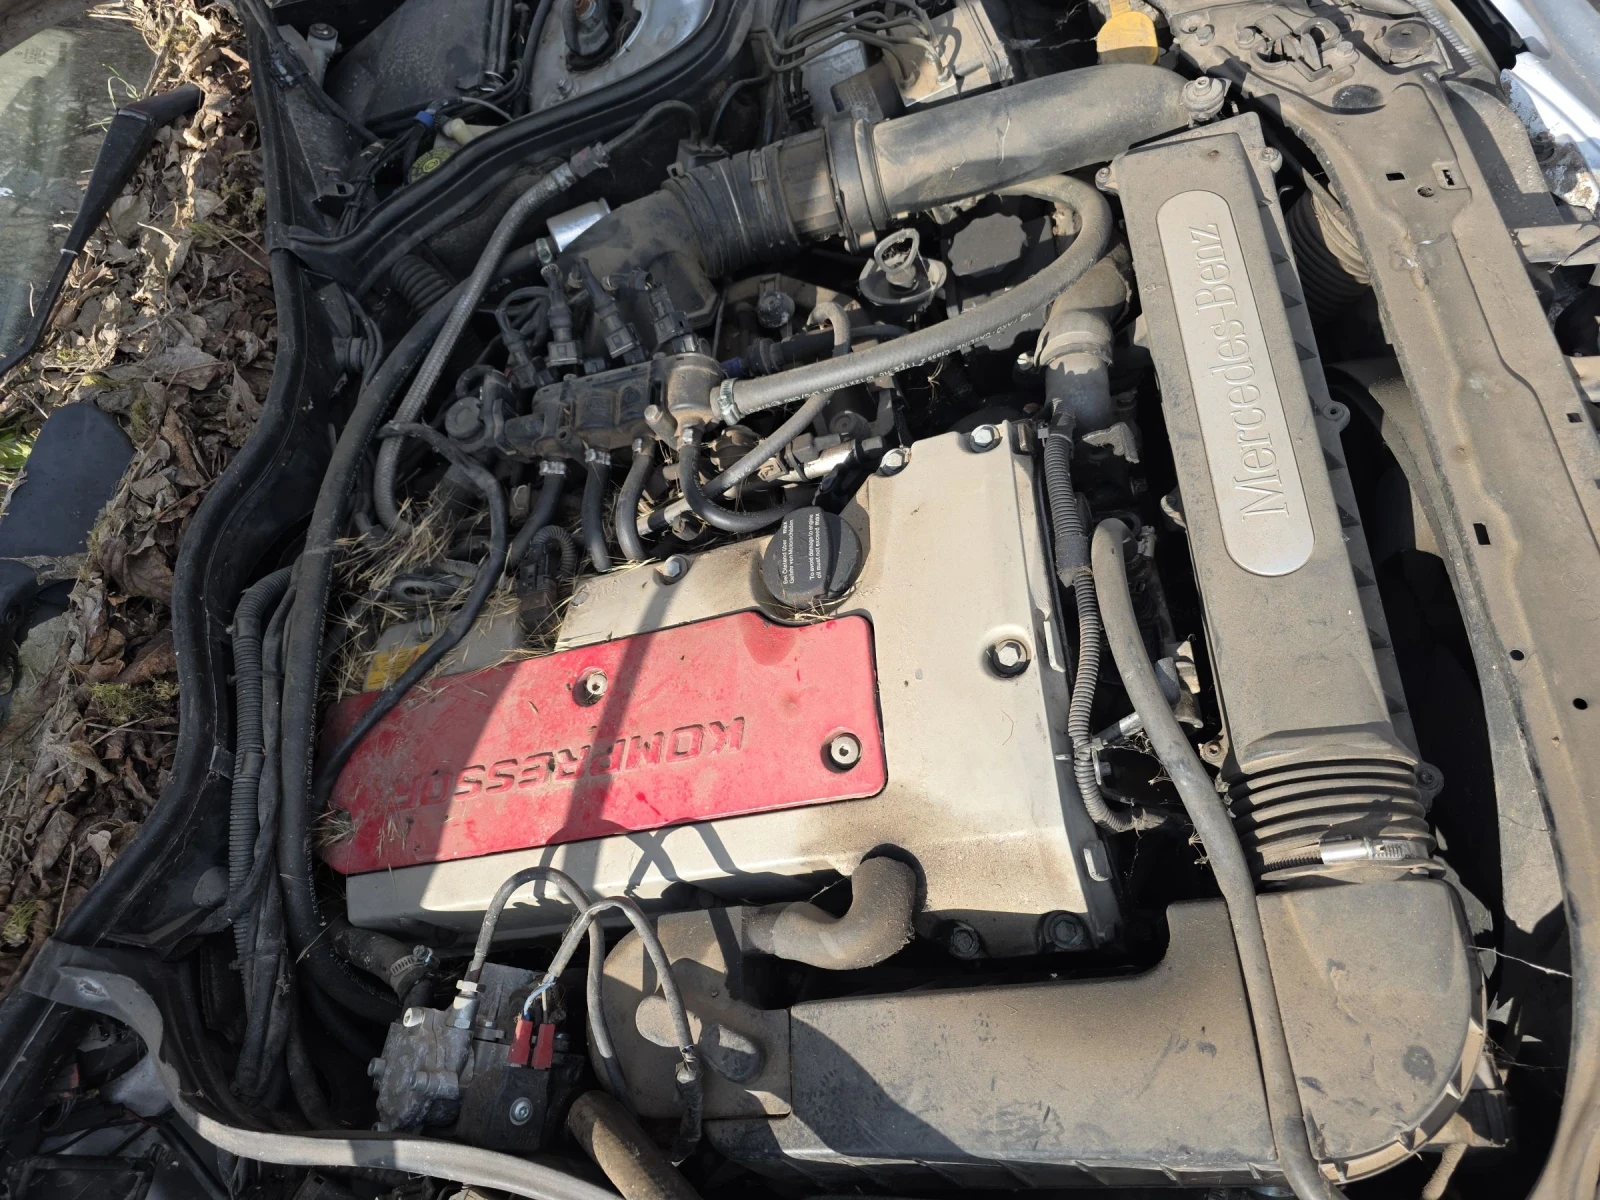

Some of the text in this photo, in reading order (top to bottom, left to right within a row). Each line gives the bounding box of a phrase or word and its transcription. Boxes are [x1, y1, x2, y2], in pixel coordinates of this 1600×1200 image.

[1188, 223, 1290, 522] Mercedes-Benz
[810, 572, 814, 580] To
[390, 715, 745, 812] KOMPRESSOR
